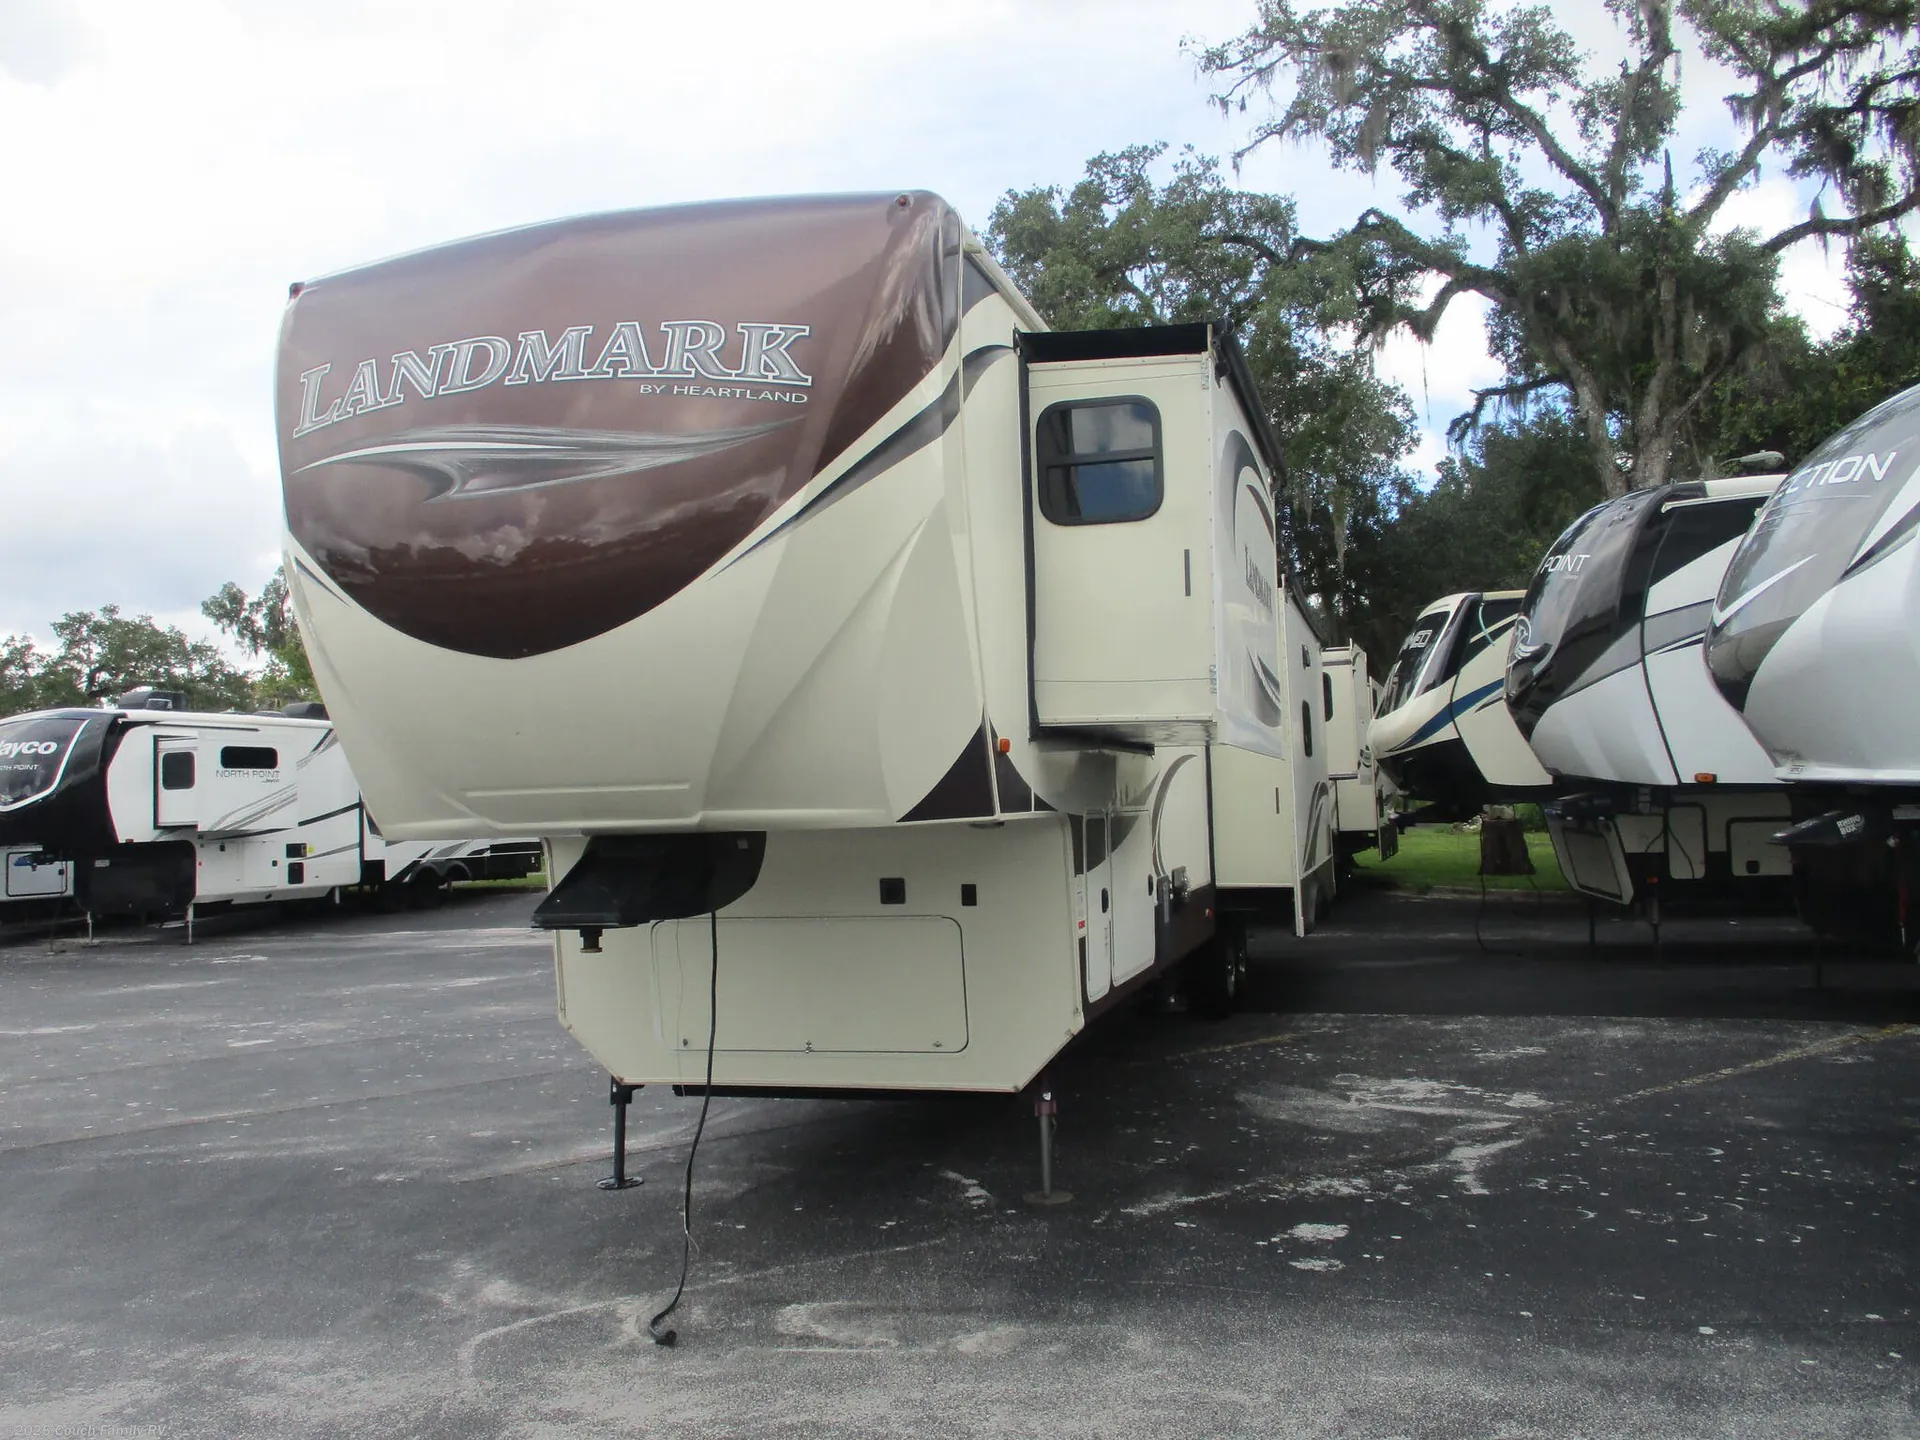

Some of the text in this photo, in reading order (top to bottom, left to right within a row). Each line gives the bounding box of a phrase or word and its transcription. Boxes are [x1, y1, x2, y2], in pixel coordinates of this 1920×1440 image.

[293, 320, 812, 438] LANDMARK
[639, 384, 808, 403] BY HEARTLAND
[1540, 554, 1591, 574] POINT
[215, 769, 280, 778] NORTH POINT
